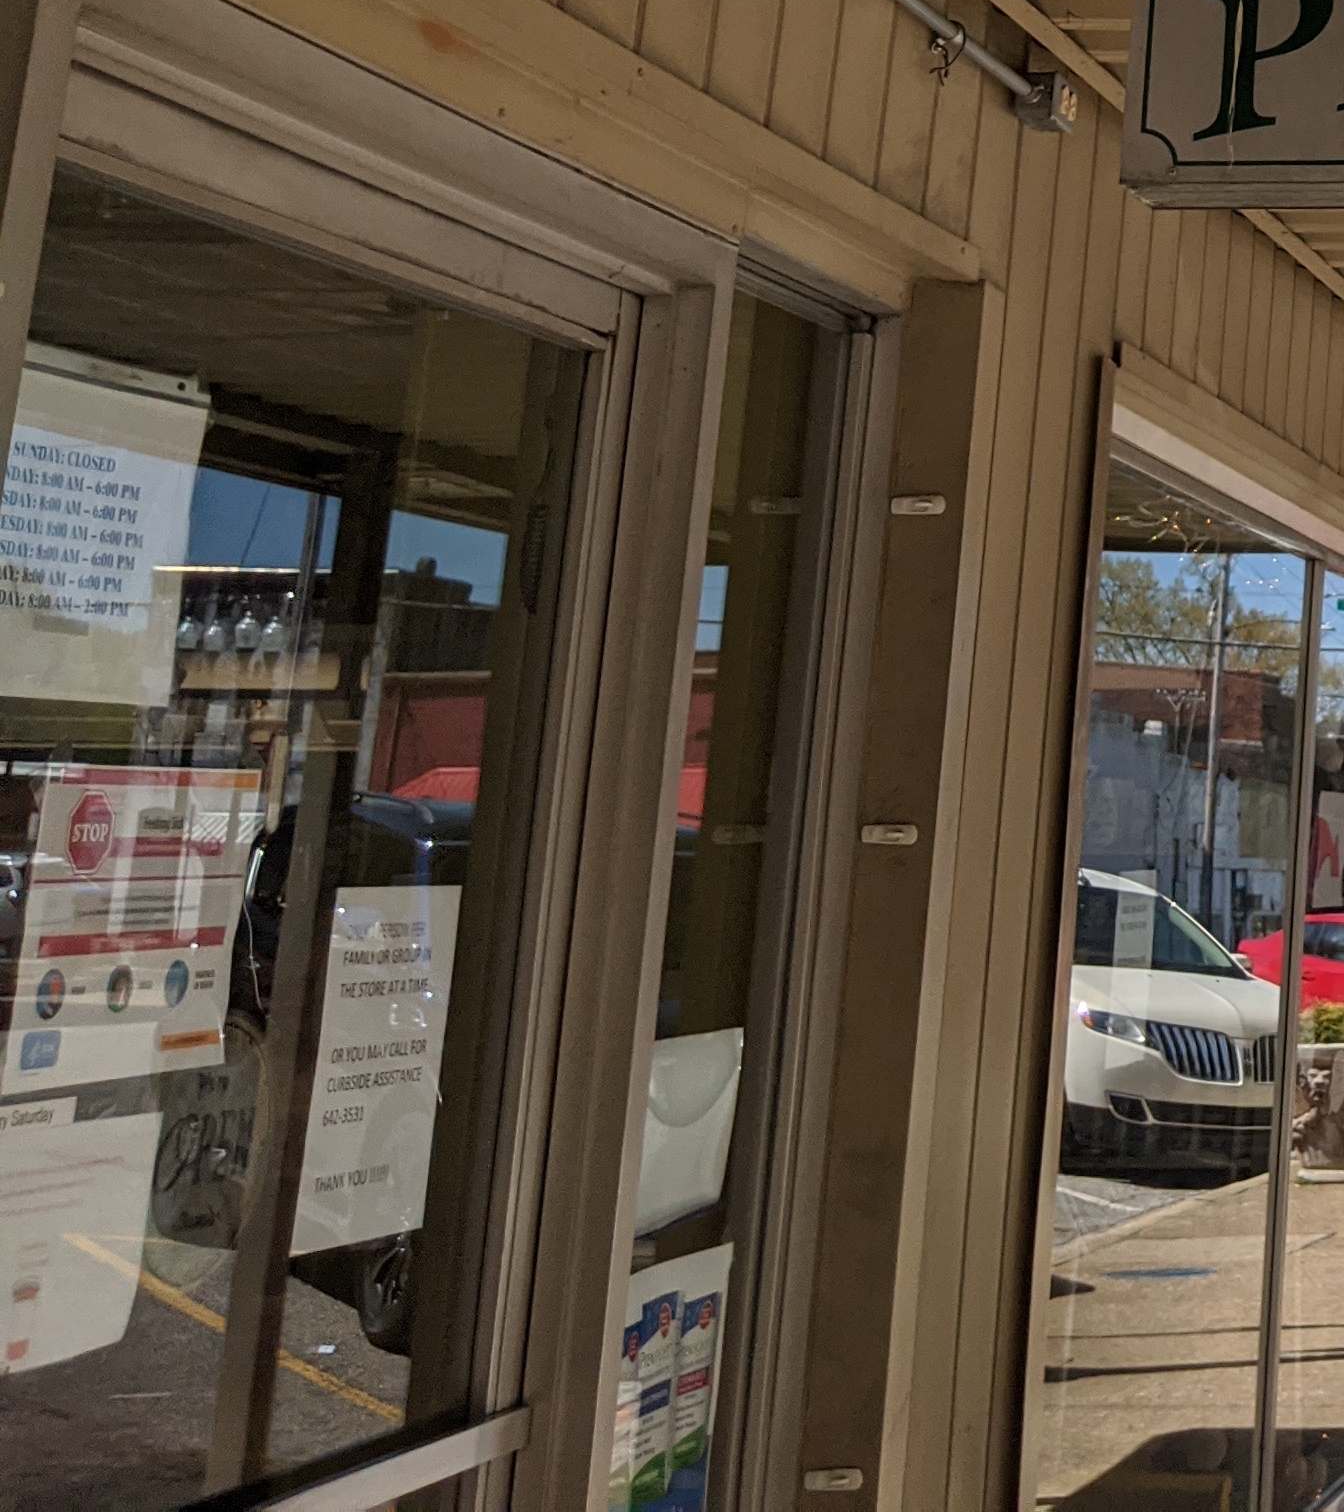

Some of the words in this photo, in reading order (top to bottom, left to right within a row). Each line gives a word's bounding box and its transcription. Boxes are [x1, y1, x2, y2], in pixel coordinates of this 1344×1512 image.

[13, 441, 65, 464] SUNDAY:
[67, 451, 116, 473] CLOSED
[121, 485, 141, 501] PM
[118, 508, 137, 524] PM
[125, 532, 143, 549] PM
[116, 554, 135, 571] PM
[103, 576, 122, 593] PM
[109, 601, 129, 617] PM
[72, 824, 107, 843] STOP
[341, 983, 356, 998] THE
[358, 981, 387, 997] STORE
[331, 1048, 344, 1065] OR
[346, 1046, 365, 1062] YOU
[367, 1044, 389, 1059] MAY
[389, 1042, 408, 1057] CALL
[410, 1039, 427, 1055] FOR
[327, 1073, 371, 1093] CURBSIDE
[373, 1067, 423, 1087] ASSISTANCE
[11, 1107, 55, 1127] Saturday
[322, 1106, 364, 1126] 642-3531
[315, 1173, 345, 1192] THANK
[348, 1169, 368, 1186] YOU
